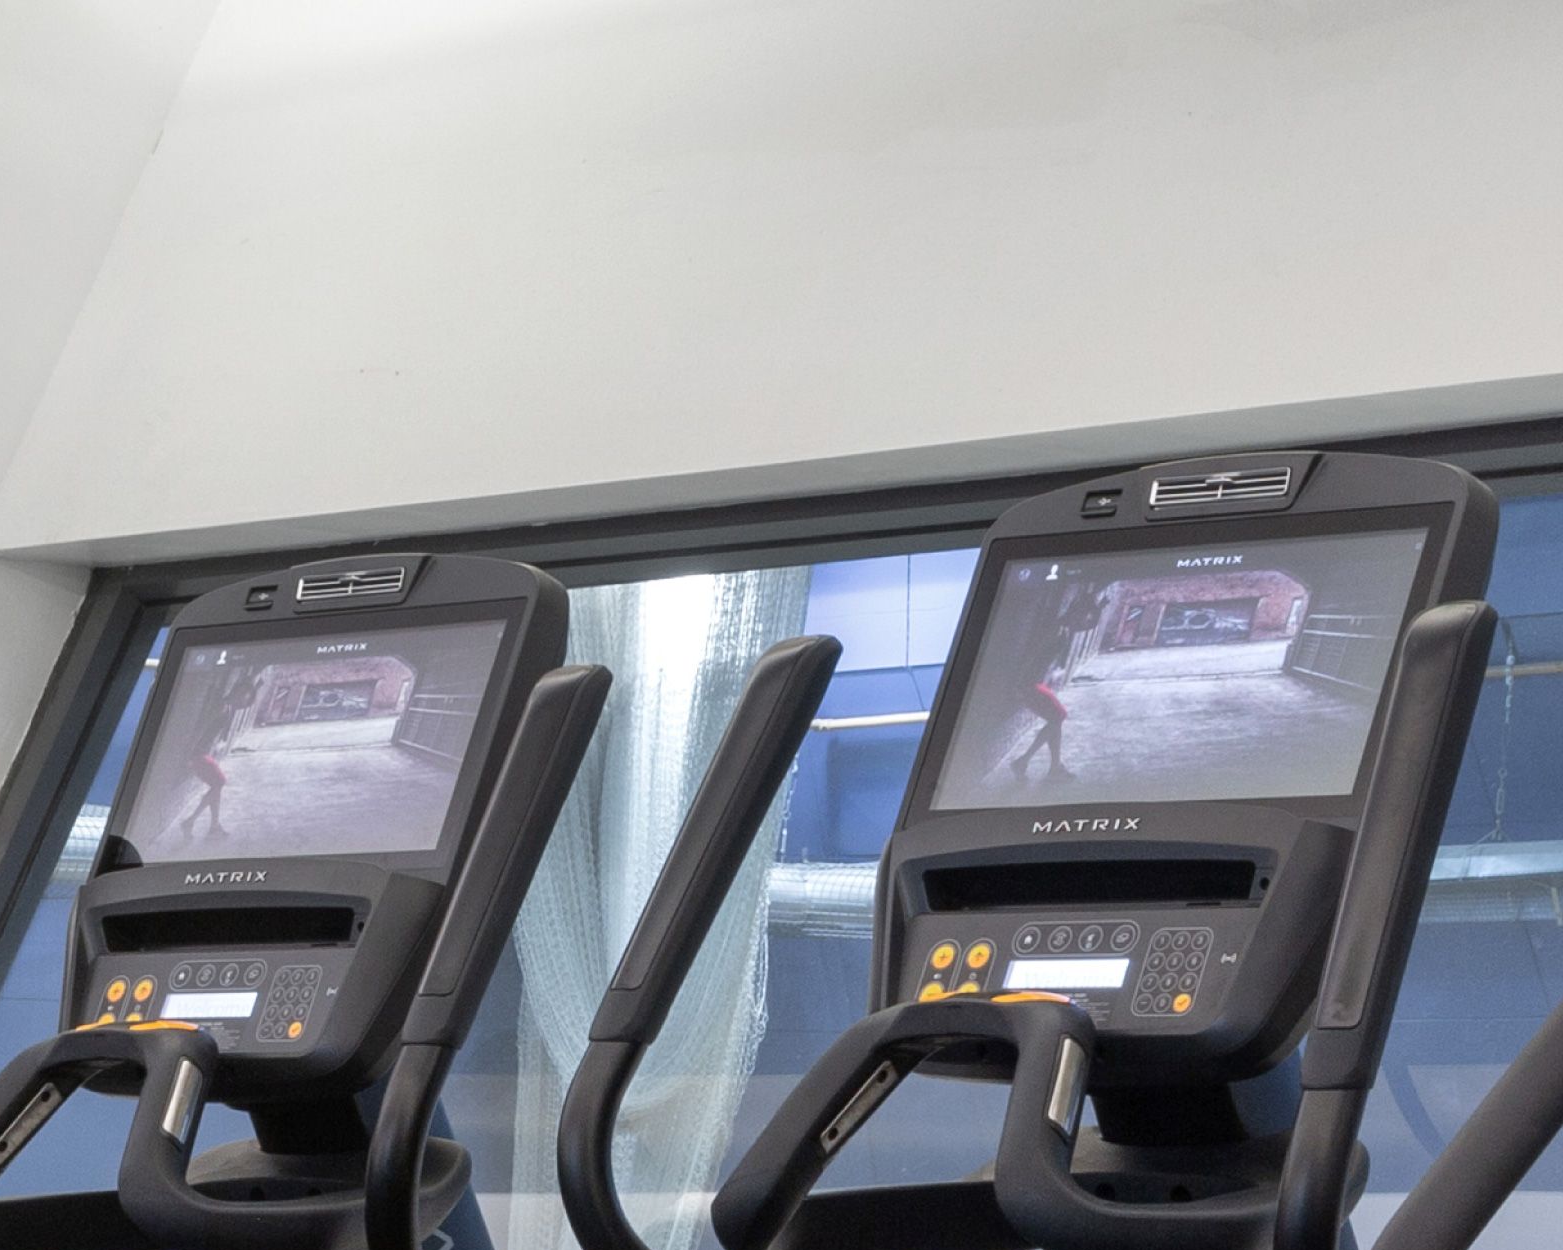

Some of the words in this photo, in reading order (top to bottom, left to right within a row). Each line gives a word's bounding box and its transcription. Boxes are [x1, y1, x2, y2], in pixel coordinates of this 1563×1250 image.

[1176, 554, 1244, 568] MATRIX
[316, 643, 367, 654] MATRIX
[1032, 816, 1142, 834] MATRIX
[184, 871, 267, 885] MATRIX
